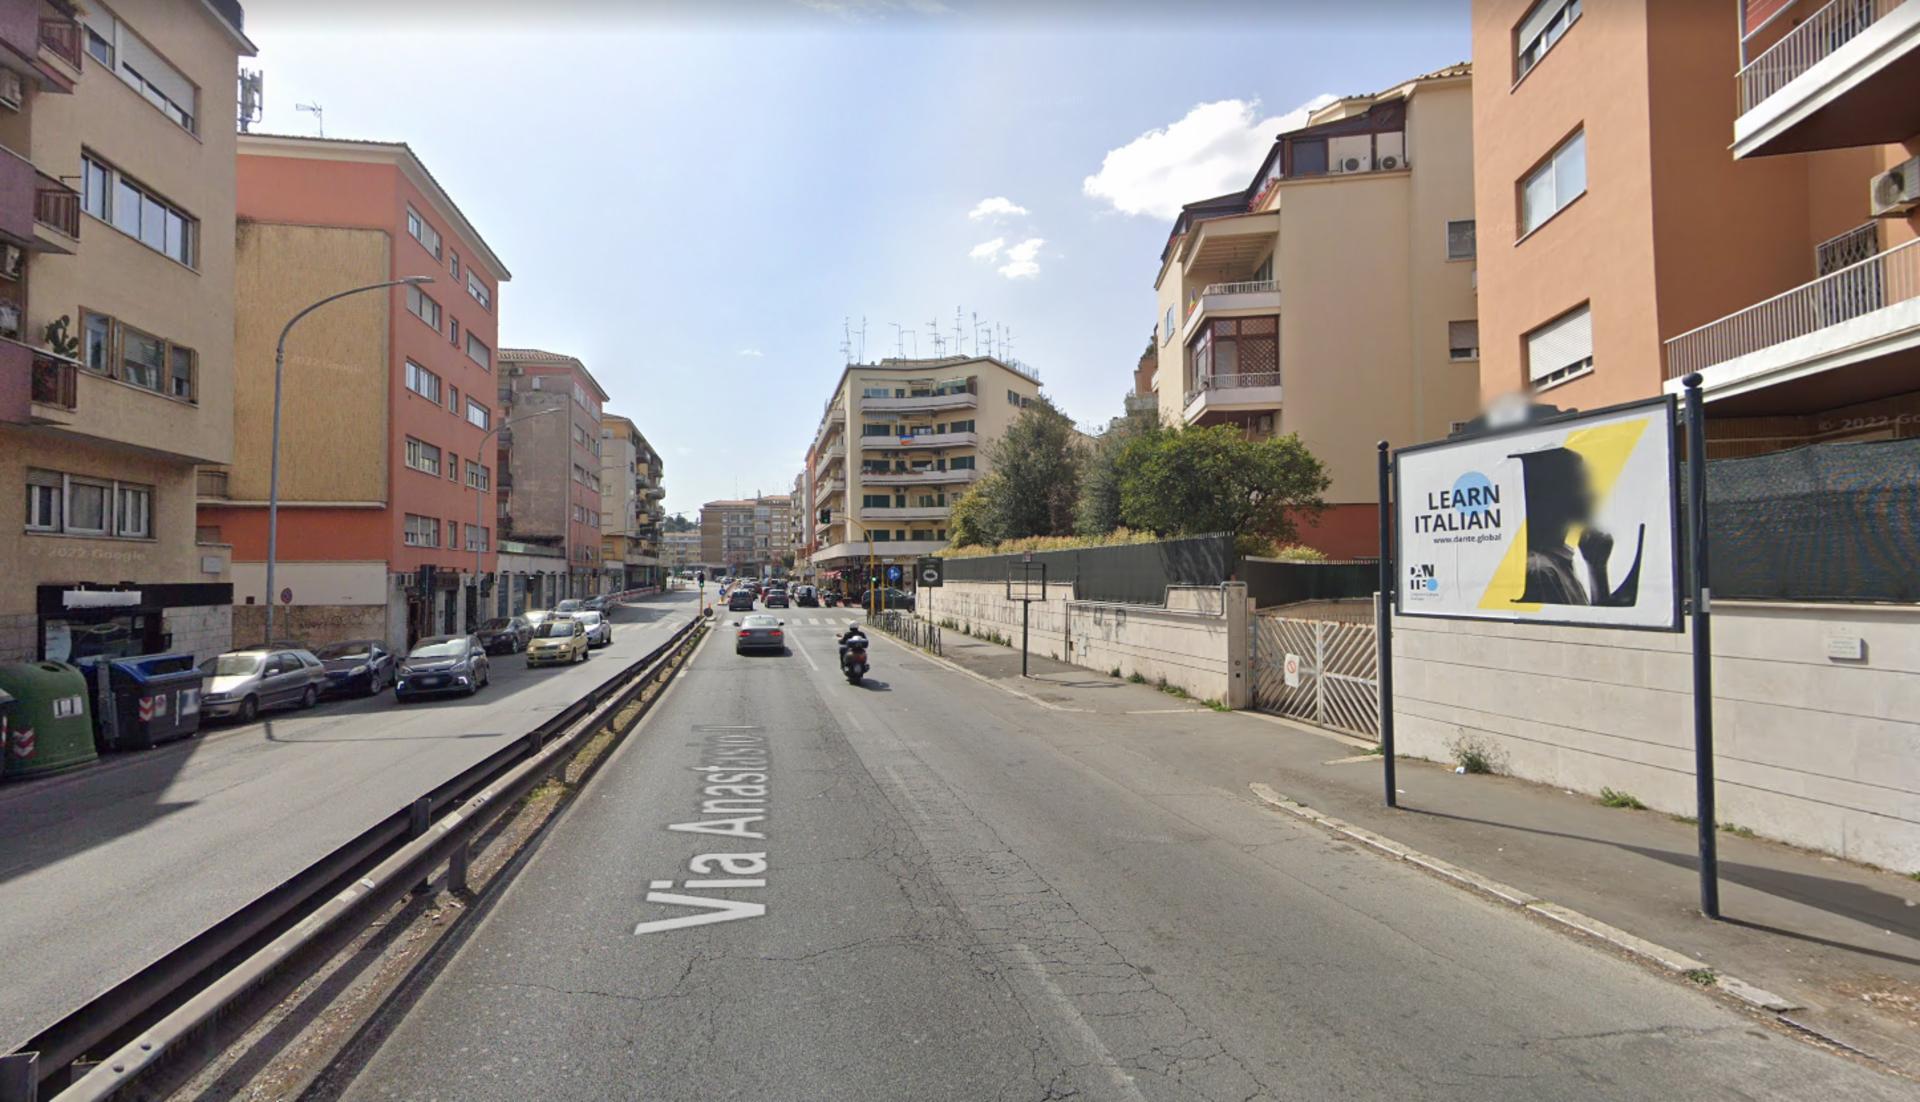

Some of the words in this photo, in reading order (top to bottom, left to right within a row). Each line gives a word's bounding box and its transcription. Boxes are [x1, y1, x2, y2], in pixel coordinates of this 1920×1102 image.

[1428, 484, 1500, 511] LEARN
[1414, 508, 1502, 534] ITALIAN
[1433, 533, 1502, 545] www.dante.global
